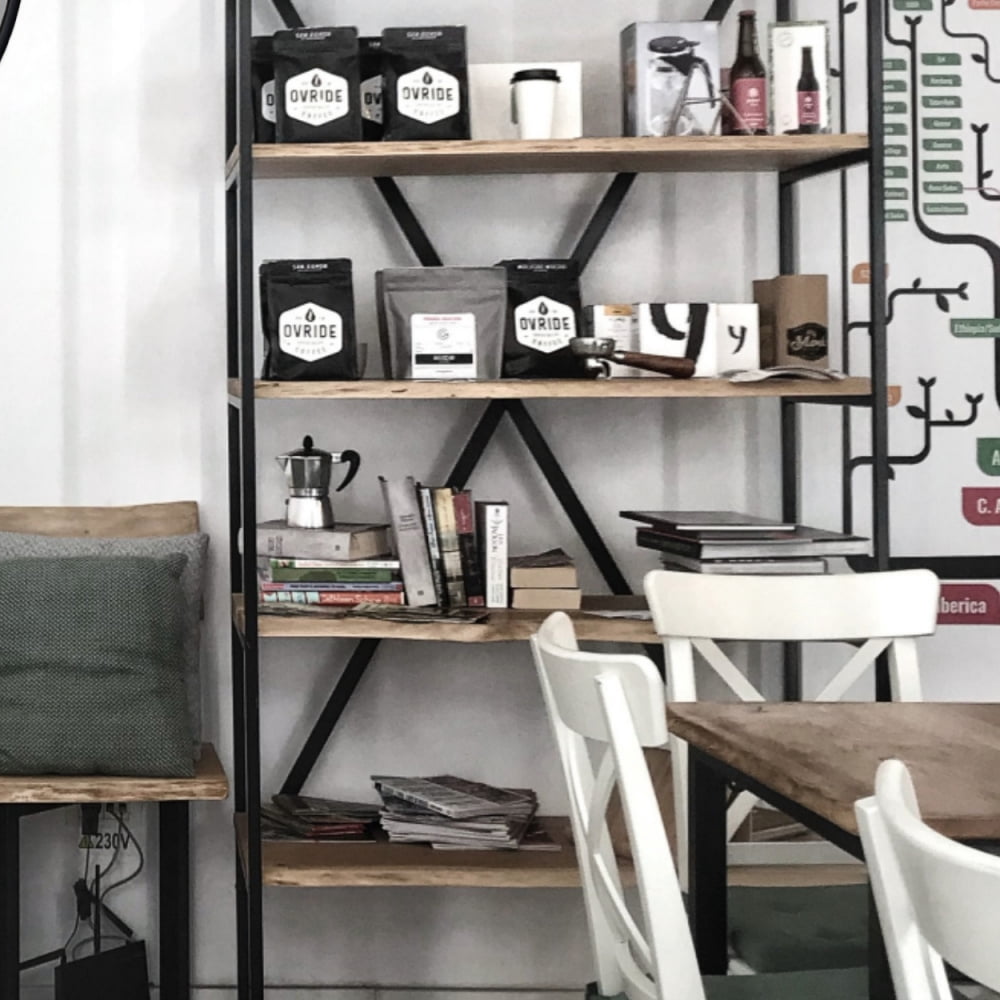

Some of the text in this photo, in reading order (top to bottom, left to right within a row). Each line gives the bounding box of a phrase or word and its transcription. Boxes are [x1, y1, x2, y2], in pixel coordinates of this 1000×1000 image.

[290, 89, 343, 103] OVRIDE
[402, 86, 454, 101] OVRIDE
[283, 324, 337, 338] OVRIDE
[519, 317, 571, 331] OVRIDE
[937, 597, 987, 614] berica
[95, 832, 131, 850] 230V
